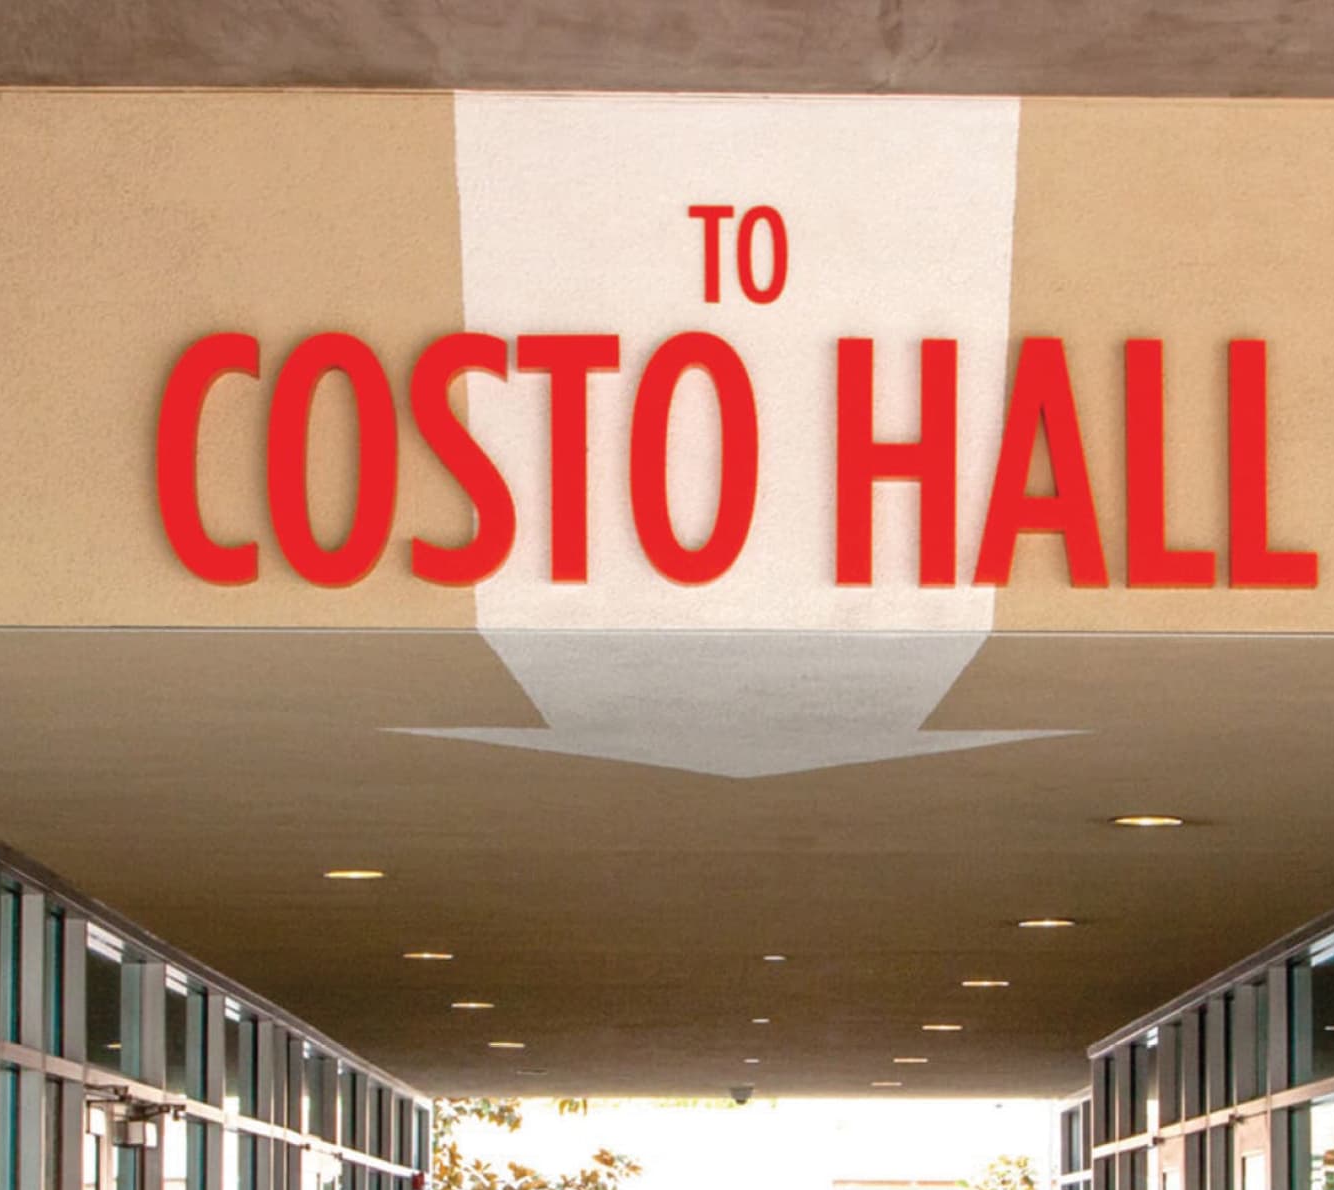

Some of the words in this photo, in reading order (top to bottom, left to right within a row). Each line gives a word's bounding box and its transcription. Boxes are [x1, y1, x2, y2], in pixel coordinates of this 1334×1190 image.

[687, 204, 788, 304] TO
[156, 331, 759, 588] COSTO
[835, 336, 1319, 589] HALL
